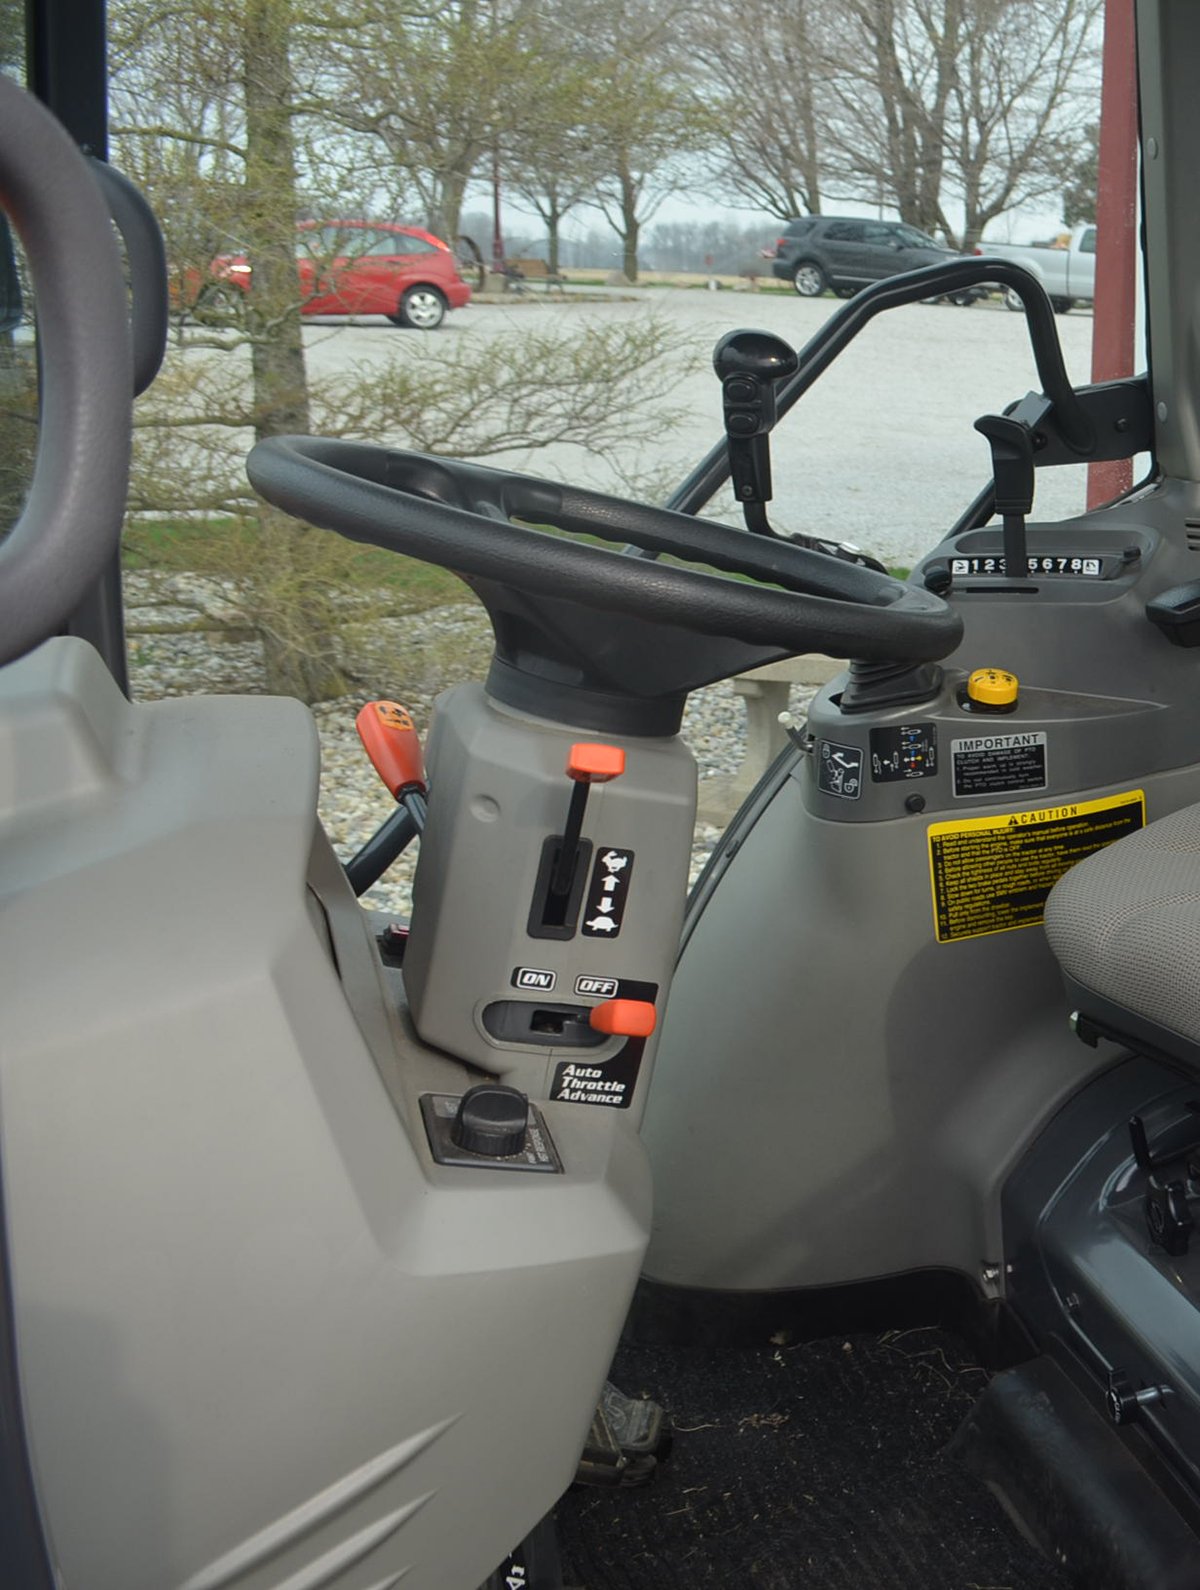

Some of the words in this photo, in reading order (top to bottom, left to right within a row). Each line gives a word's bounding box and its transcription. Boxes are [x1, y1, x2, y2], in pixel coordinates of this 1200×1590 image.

[959, 734, 1039, 751] IMPORTANT
[1021, 807, 1078, 824] CAUTION
[522, 973, 551, 987] ON
[578, 980, 616, 994] OFF
[562, 1064, 602, 1078] Auto
[561, 1076, 626, 1093] Throttle
[557, 1088, 623, 1104] Advance
